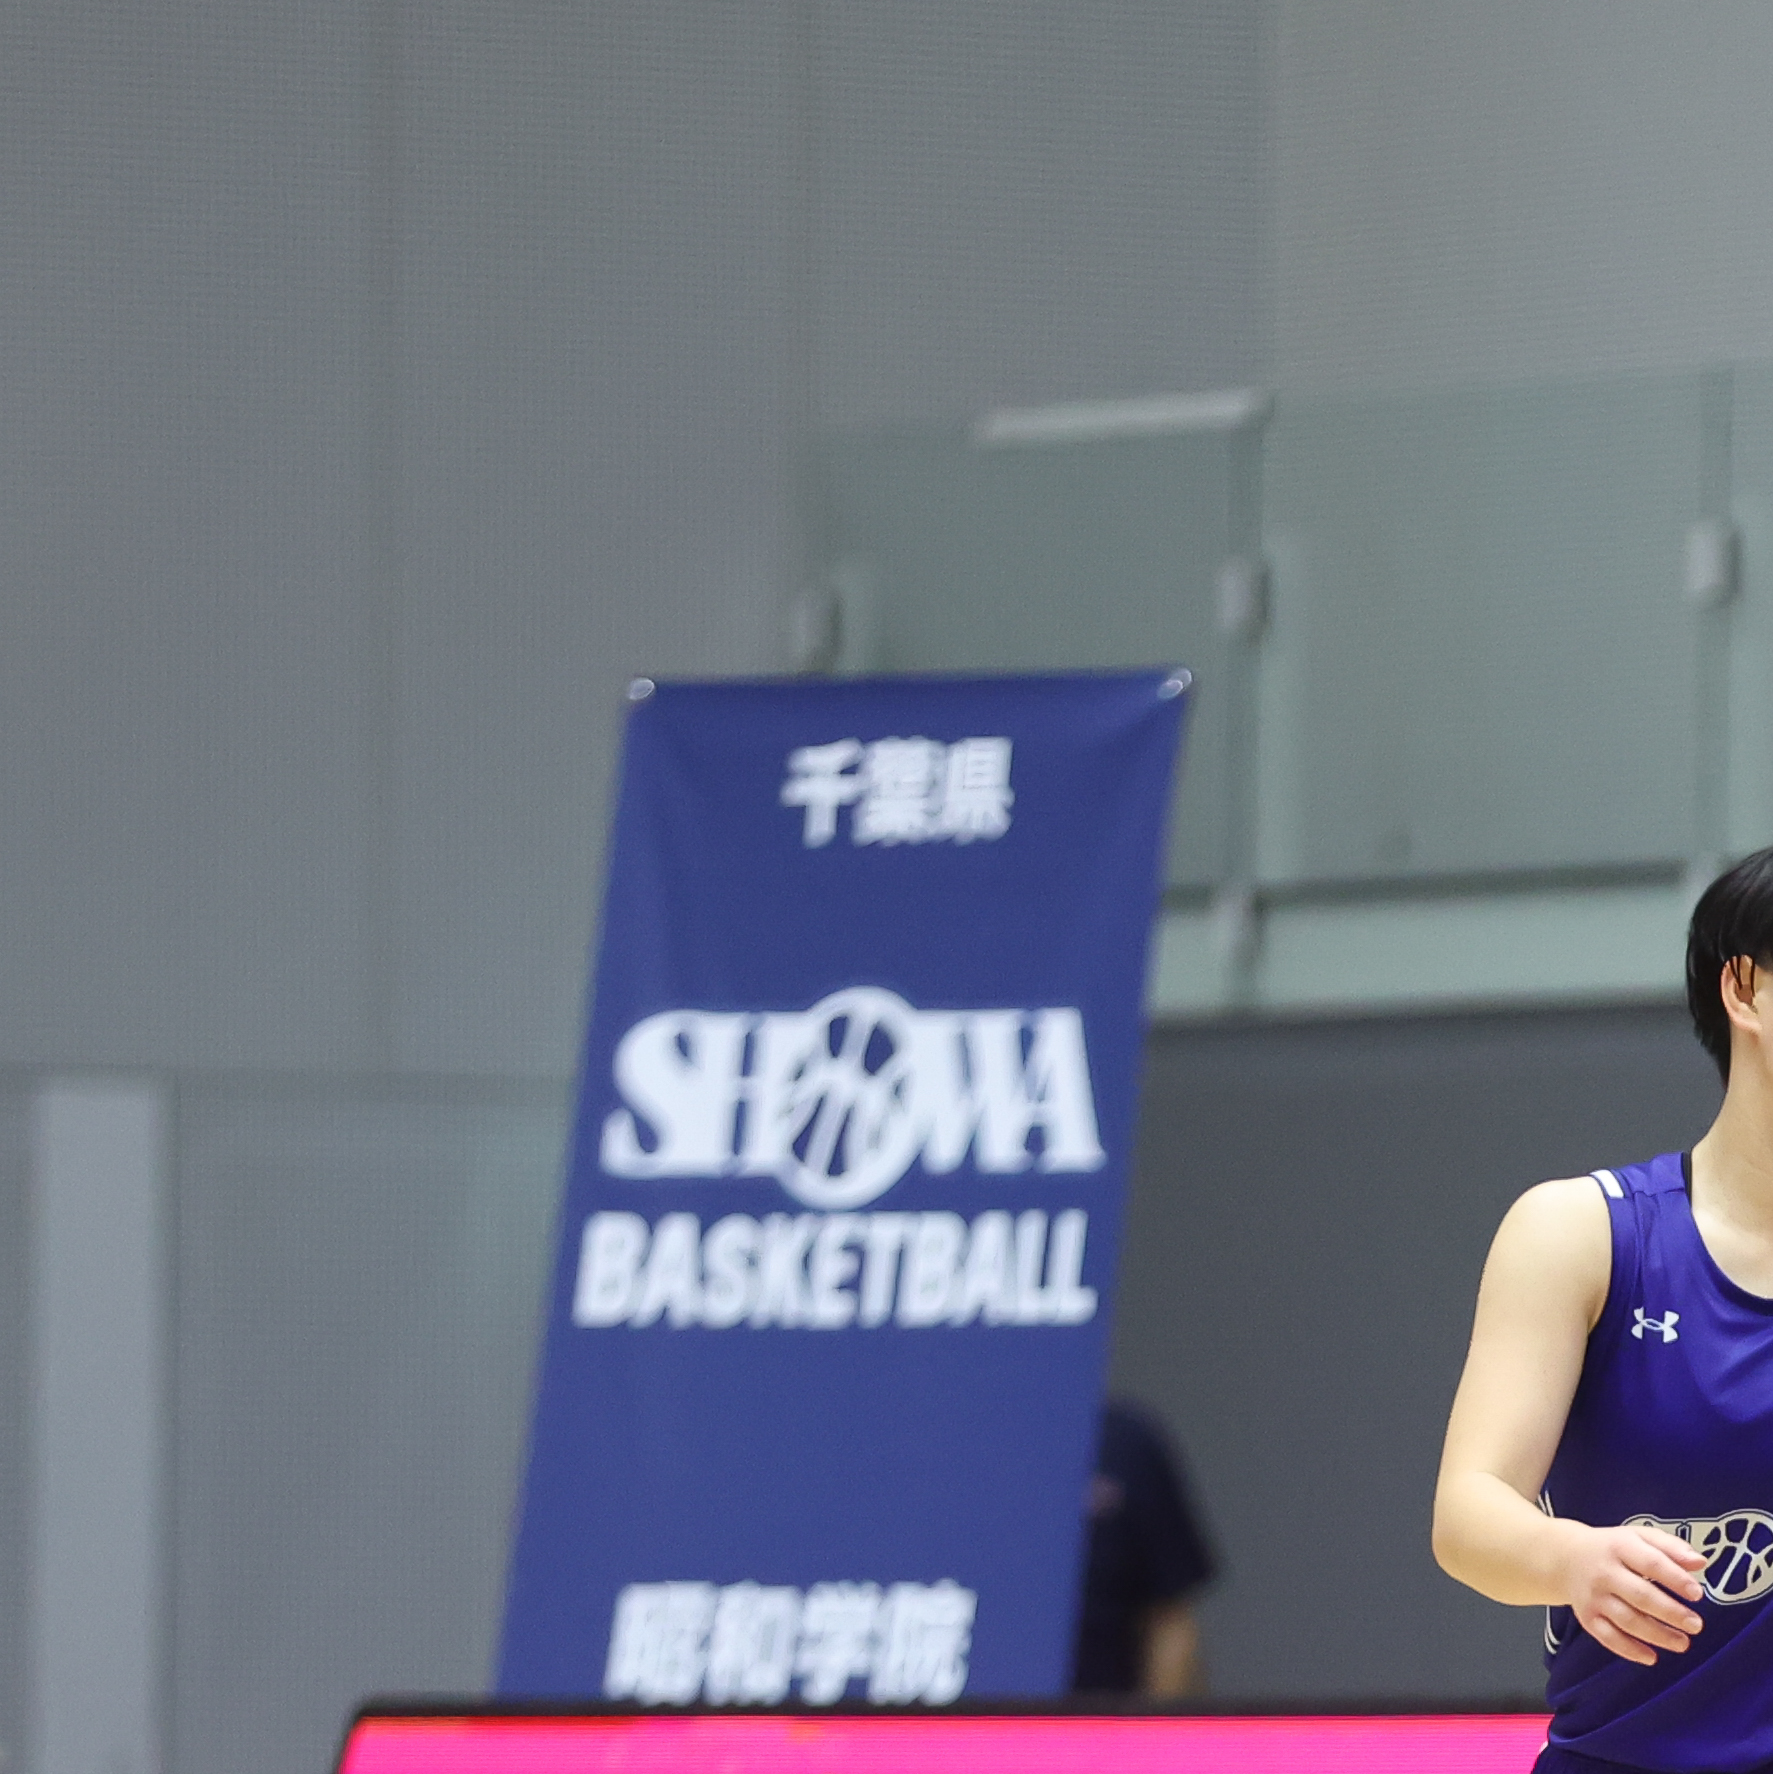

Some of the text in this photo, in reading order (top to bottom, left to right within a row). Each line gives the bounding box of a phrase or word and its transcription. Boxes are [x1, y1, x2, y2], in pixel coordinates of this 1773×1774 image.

[784, 737, 1014, 846] 千葉県
[600, 985, 1106, 1207] SHOWA
[573, 1210, 1097, 1329] BASKETBALL
[602, 1580, 977, 1704] 昭和学院
